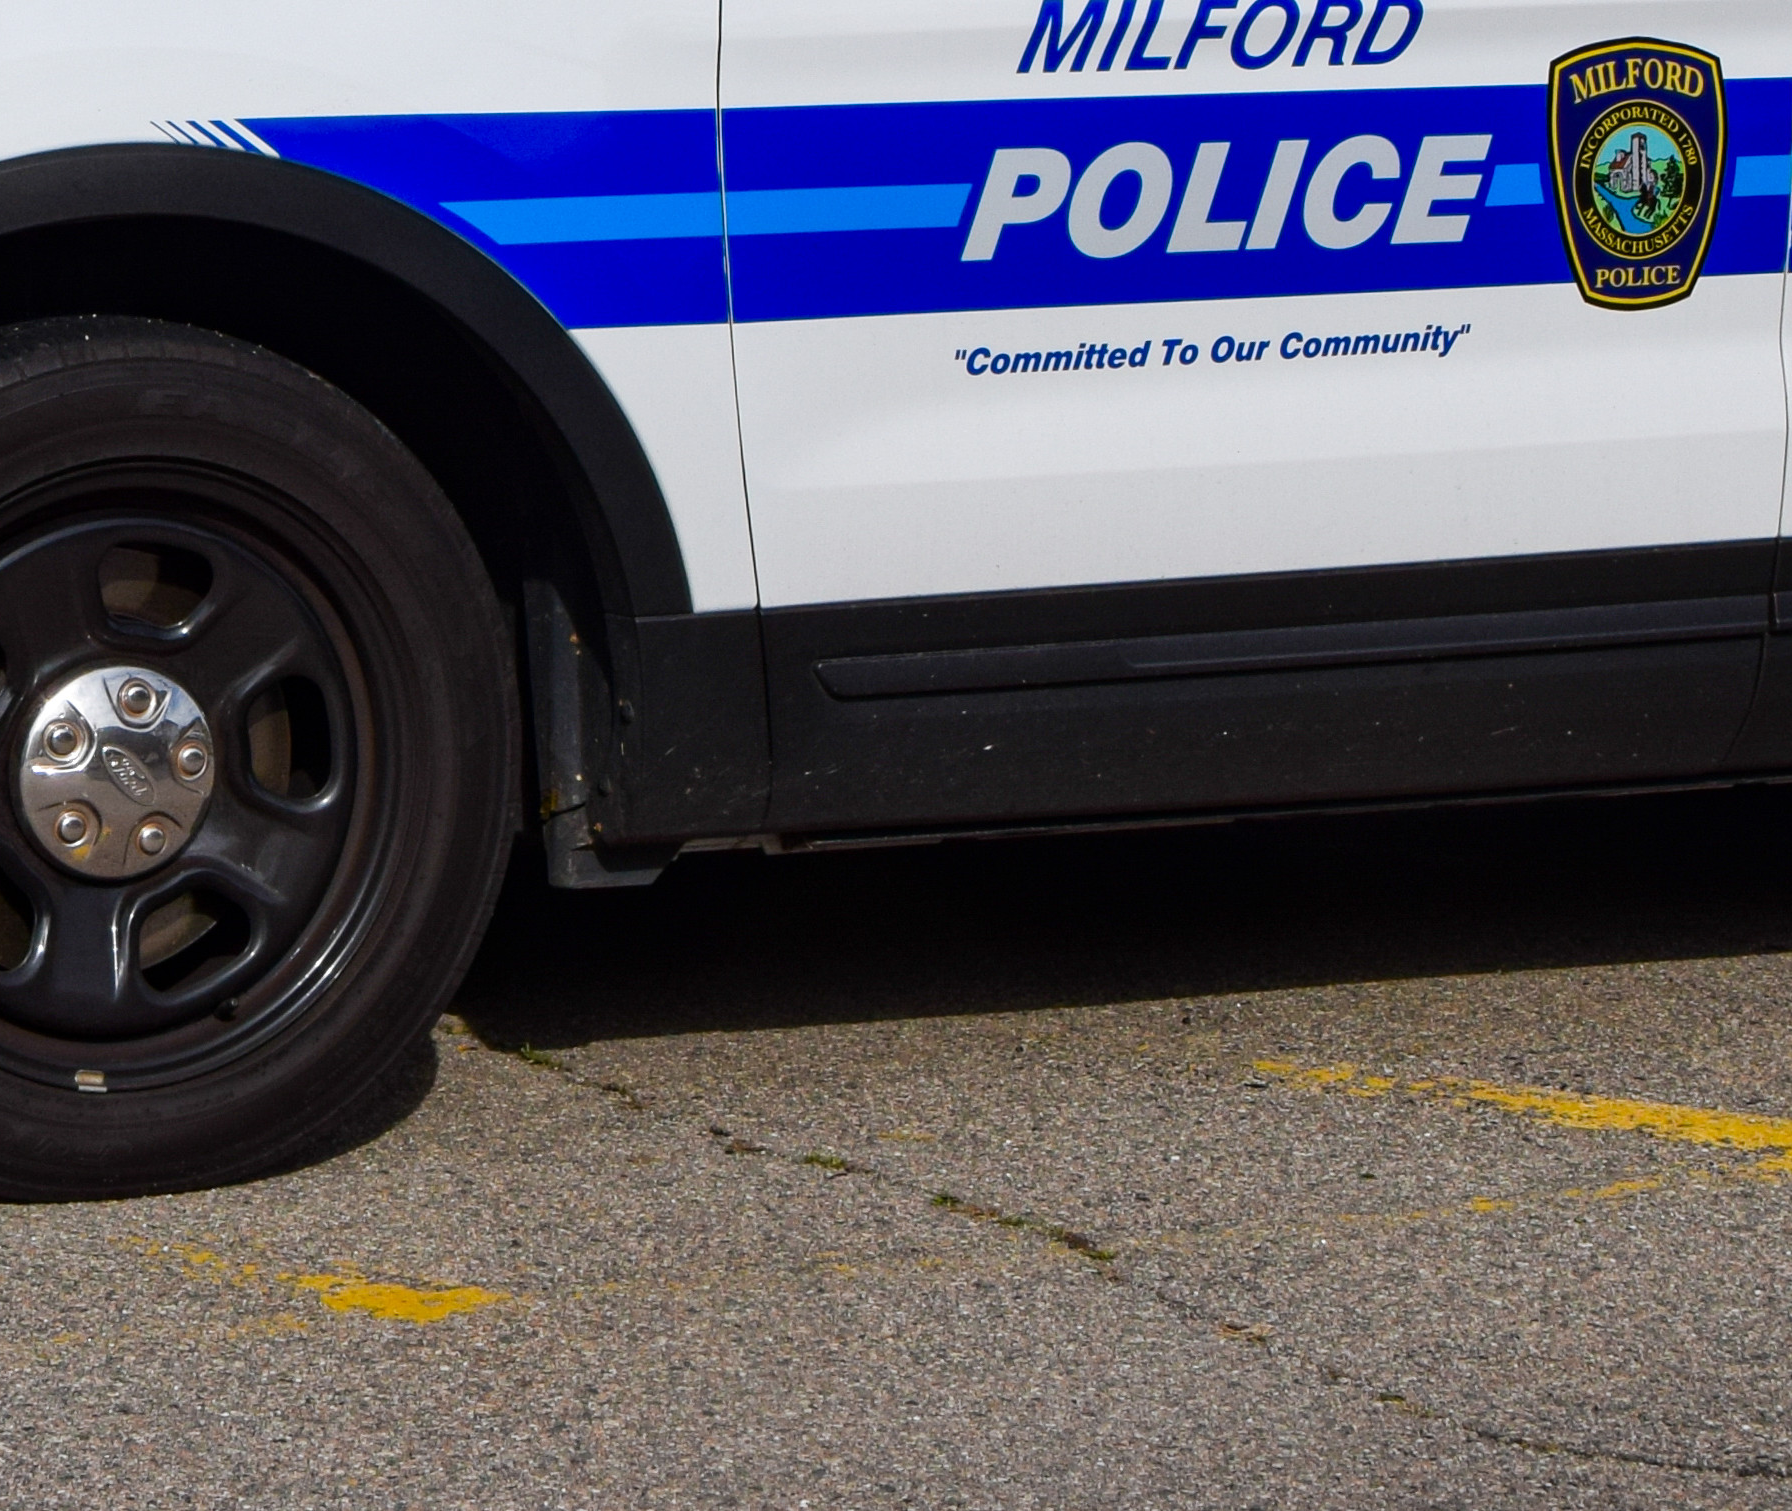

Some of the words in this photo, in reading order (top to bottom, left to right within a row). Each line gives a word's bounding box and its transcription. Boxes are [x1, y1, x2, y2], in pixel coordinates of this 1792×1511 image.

[1569, 58, 1704, 104] MILFORD
[1579, 105, 1680, 170] INCORPORATED
[1677, 132, 1698, 166] 1780
[961, 134, 1493, 262] POLICE
[1582, 203, 1694, 255] MASSACHUSETTS
[1595, 264, 1681, 289] POLICE
[954, 340, 1152, 376] "Committed
[1162, 338, 1200, 365] To
[1210, 335, 1271, 364] Our
[1279, 324, 1472, 359] Community"
